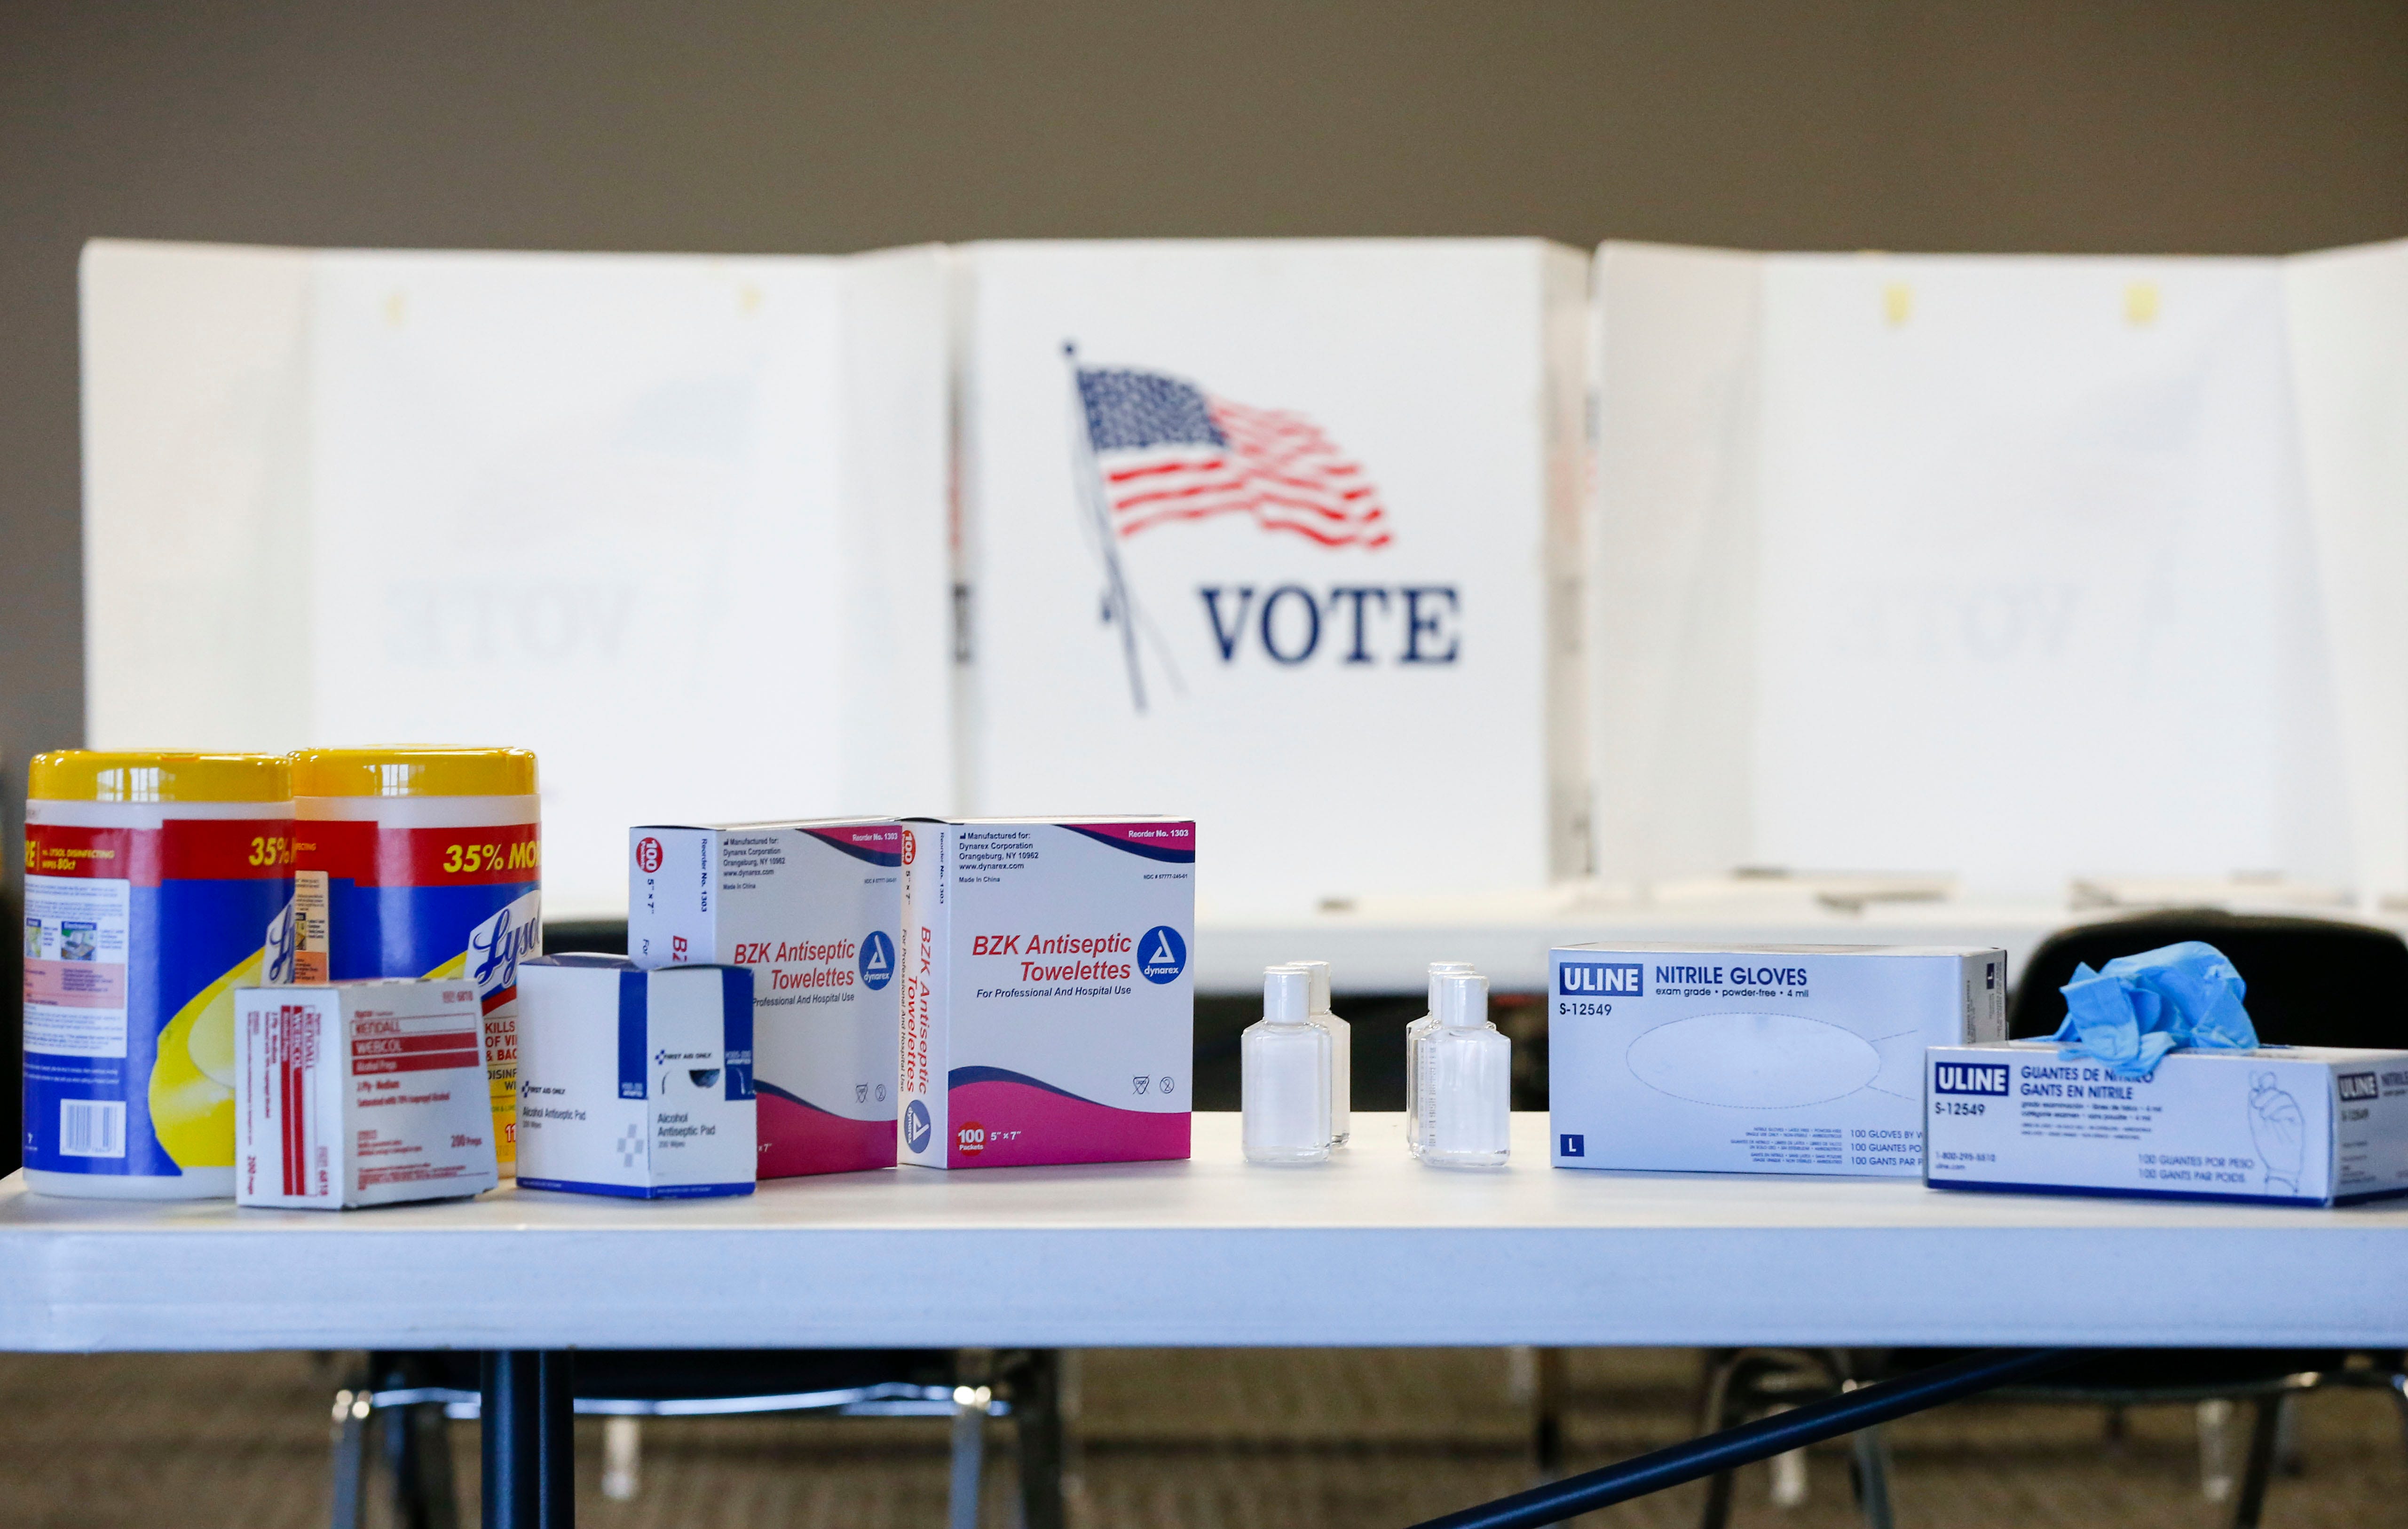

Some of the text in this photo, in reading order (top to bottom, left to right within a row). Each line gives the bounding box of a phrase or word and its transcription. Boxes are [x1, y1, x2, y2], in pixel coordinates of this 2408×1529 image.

[1194, 586, 1463, 664] VOTE
[730, 836, 779, 845] Manufactured for:
[959, 843, 988, 851] Dynarex
[248, 836, 290, 866] 35%
[646, 840, 657, 871] 100
[723, 848, 781, 858] Dynarex Corporation
[959, 852, 1004, 861] Orangeburg,
[443, 844, 502, 873] 35%
[723, 859, 758, 867] Orangeburg,
[723, 869, 774, 878] www.dynarex.com
[959, 862, 1024, 871] www.dynarex.com
[647, 879, 655, 891] 5"
[647, 902, 655, 914] 7"
[734, 939, 855, 965] BZK Antiseptic
[972, 932, 1131, 958] BZK Antiseptic
[864, 972, 890, 983] dynarex
[1020, 960, 1130, 982] Towelettes
[1144, 965, 1179, 977] dynarex
[1656, 966, 1807, 986] NITRILE GLOVES
[772, 967, 854, 990] Towelettes
[1564, 967, 1638, 992] ULINE
[977, 985, 1131, 998] For Professional And Hospital Use
[1683, 988, 1711, 997] grade
[1722, 988, 1776, 998] powder-free
[753, 992, 854, 1007] Professional And Hospital Use
[917, 926, 931, 1095] BZK Antiseptic
[1560, 1002, 1612, 1016] S-12549
[485, 1021, 515, 1034] KILLS
[907, 976, 917, 1093] Towelettes
[356, 1038, 402, 1055] WEBCOL
[485, 1036, 501, 1048] OF
[486, 1049, 493, 1062] &
[1939, 1066, 2006, 1092] ULINE
[2021, 1065, 2078, 1080] GUANTES
[2083, 1068, 2100, 1081] DE
[2021, 1083, 2133, 1100] GANTS EN NITRILE
[2340, 1075, 2376, 1097] ULINE
[523, 1106, 586, 1121] Alcohol Antiseptic Pad
[1935, 1102, 1986, 1116] S-12549
[658, 1113, 688, 1123] Alcohol
[657, 1125, 716, 1137] Antiseptic Pad
[958, 1128, 984, 1143] 100
[990, 1131, 1001, 1141] 5"
[1010, 1131, 1021, 1141] 7"
[1850, 1129, 1866, 1138] 100
[1868, 1130, 1901, 1139] GLOVES
[764, 1143, 772, 1152] 7"
[1569, 1138, 1576, 1152] L
[1851, 1143, 1906, 1152] 100 GUANTES
[1851, 1157, 1916, 1166] 100 GANTS PAR
[2139, 1154, 2255, 1169] 100 GUANTES POR PESO
[2139, 1168, 2156, 1179] 100
[2159, 1169, 2191, 1180] GANTS
[2194, 1171, 2212, 1181] PAR
